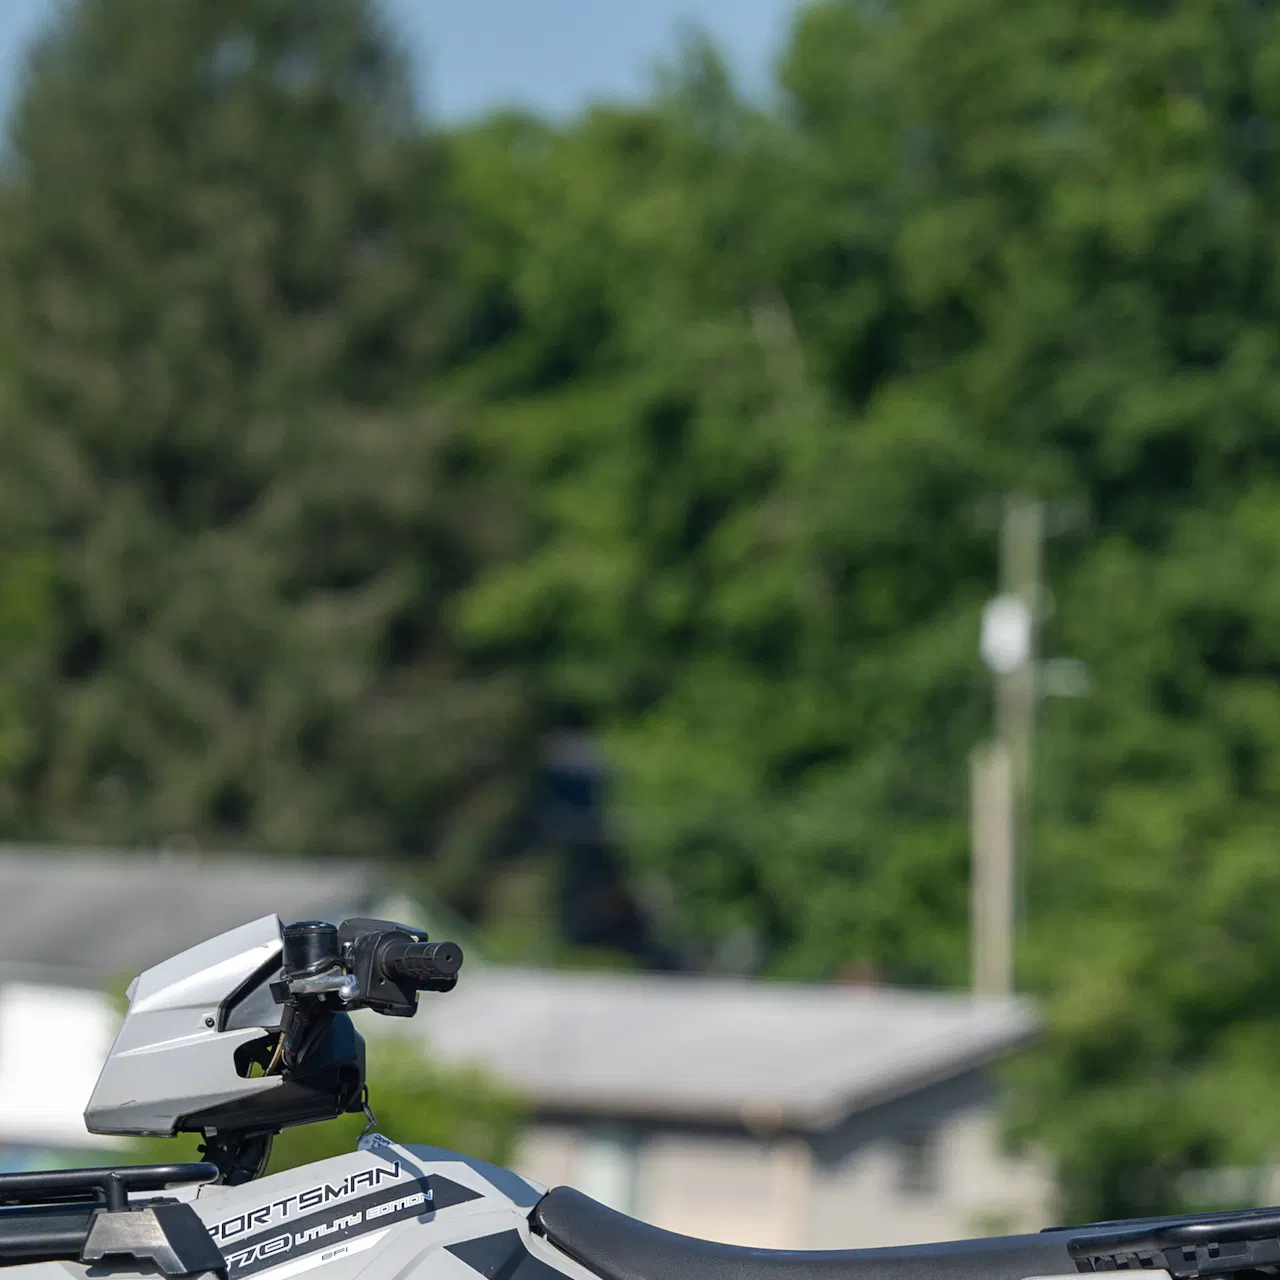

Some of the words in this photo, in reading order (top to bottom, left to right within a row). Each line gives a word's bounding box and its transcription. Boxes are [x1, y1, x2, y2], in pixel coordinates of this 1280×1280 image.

[224, 1233, 292, 1271] 70
[295, 1211, 363, 1245] UTILITY
[366, 1189, 434, 1220] EDITION
[321, 1246, 349, 1261] EFI
